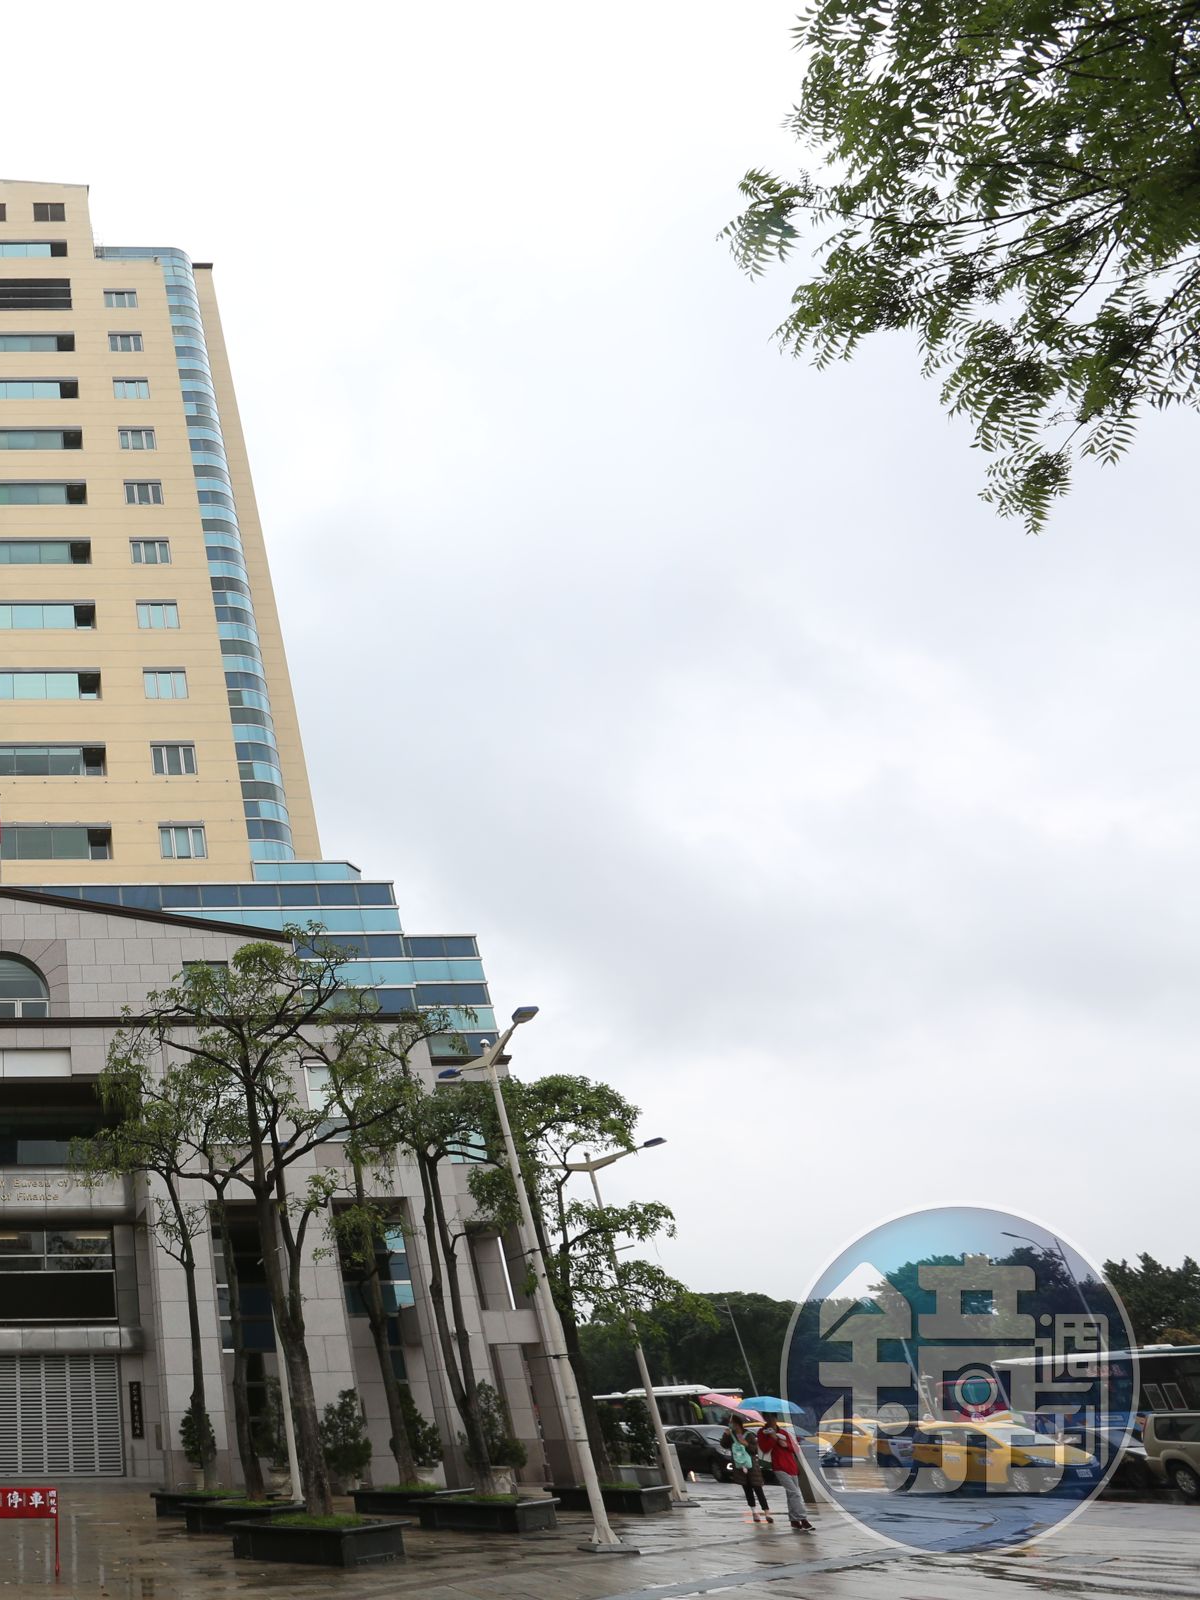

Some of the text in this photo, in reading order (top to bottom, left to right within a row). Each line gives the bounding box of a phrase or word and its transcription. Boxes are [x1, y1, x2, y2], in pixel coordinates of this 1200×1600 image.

[13, 1179, 52, 1188] Bureau
[57, 1179, 69, 1188] of
[0, 1192, 12, 1202] of
[16, 1192, 60, 1201] Finance
